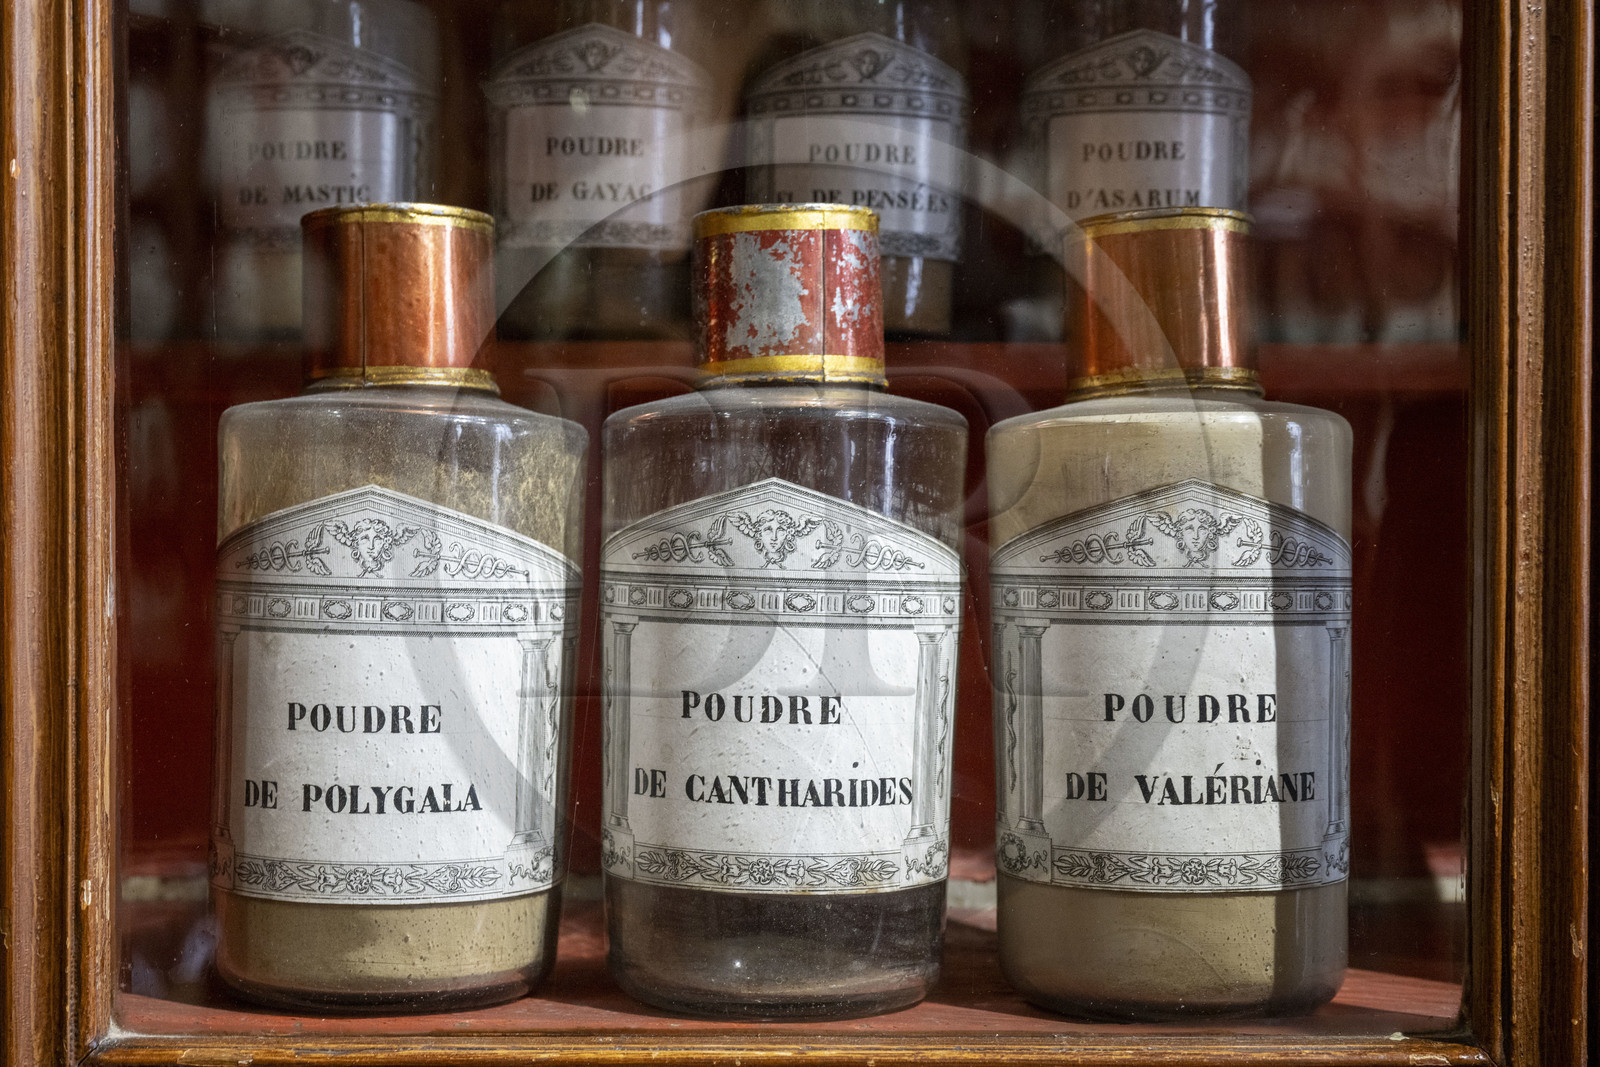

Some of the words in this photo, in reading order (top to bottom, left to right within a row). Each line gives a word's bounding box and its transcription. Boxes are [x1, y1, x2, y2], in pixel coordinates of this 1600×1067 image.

[546, 136, 644, 157] POUDRE
[809, 143, 917, 165] POUDRE
[1082, 140, 1186, 162] POUDRE
[239, 186, 268, 205] DE
[531, 182, 559, 203] DE
[812, 189, 842, 205] DE
[851, 182, 949, 213] PENSÉES
[287, 702, 442, 734] POUDRE
[681, 690, 842, 725] POUDRE
[1103, 693, 1277, 723] POUDRE
[244, 779, 279, 809] DE
[301, 783, 483, 815] POLYGALA
[634, 767, 667, 799] DE
[685, 773, 913, 808] CANTHARIDES
[1065, 772, 1108, 802] DE
[1134, 762, 1316, 806] VALÉRIANE
